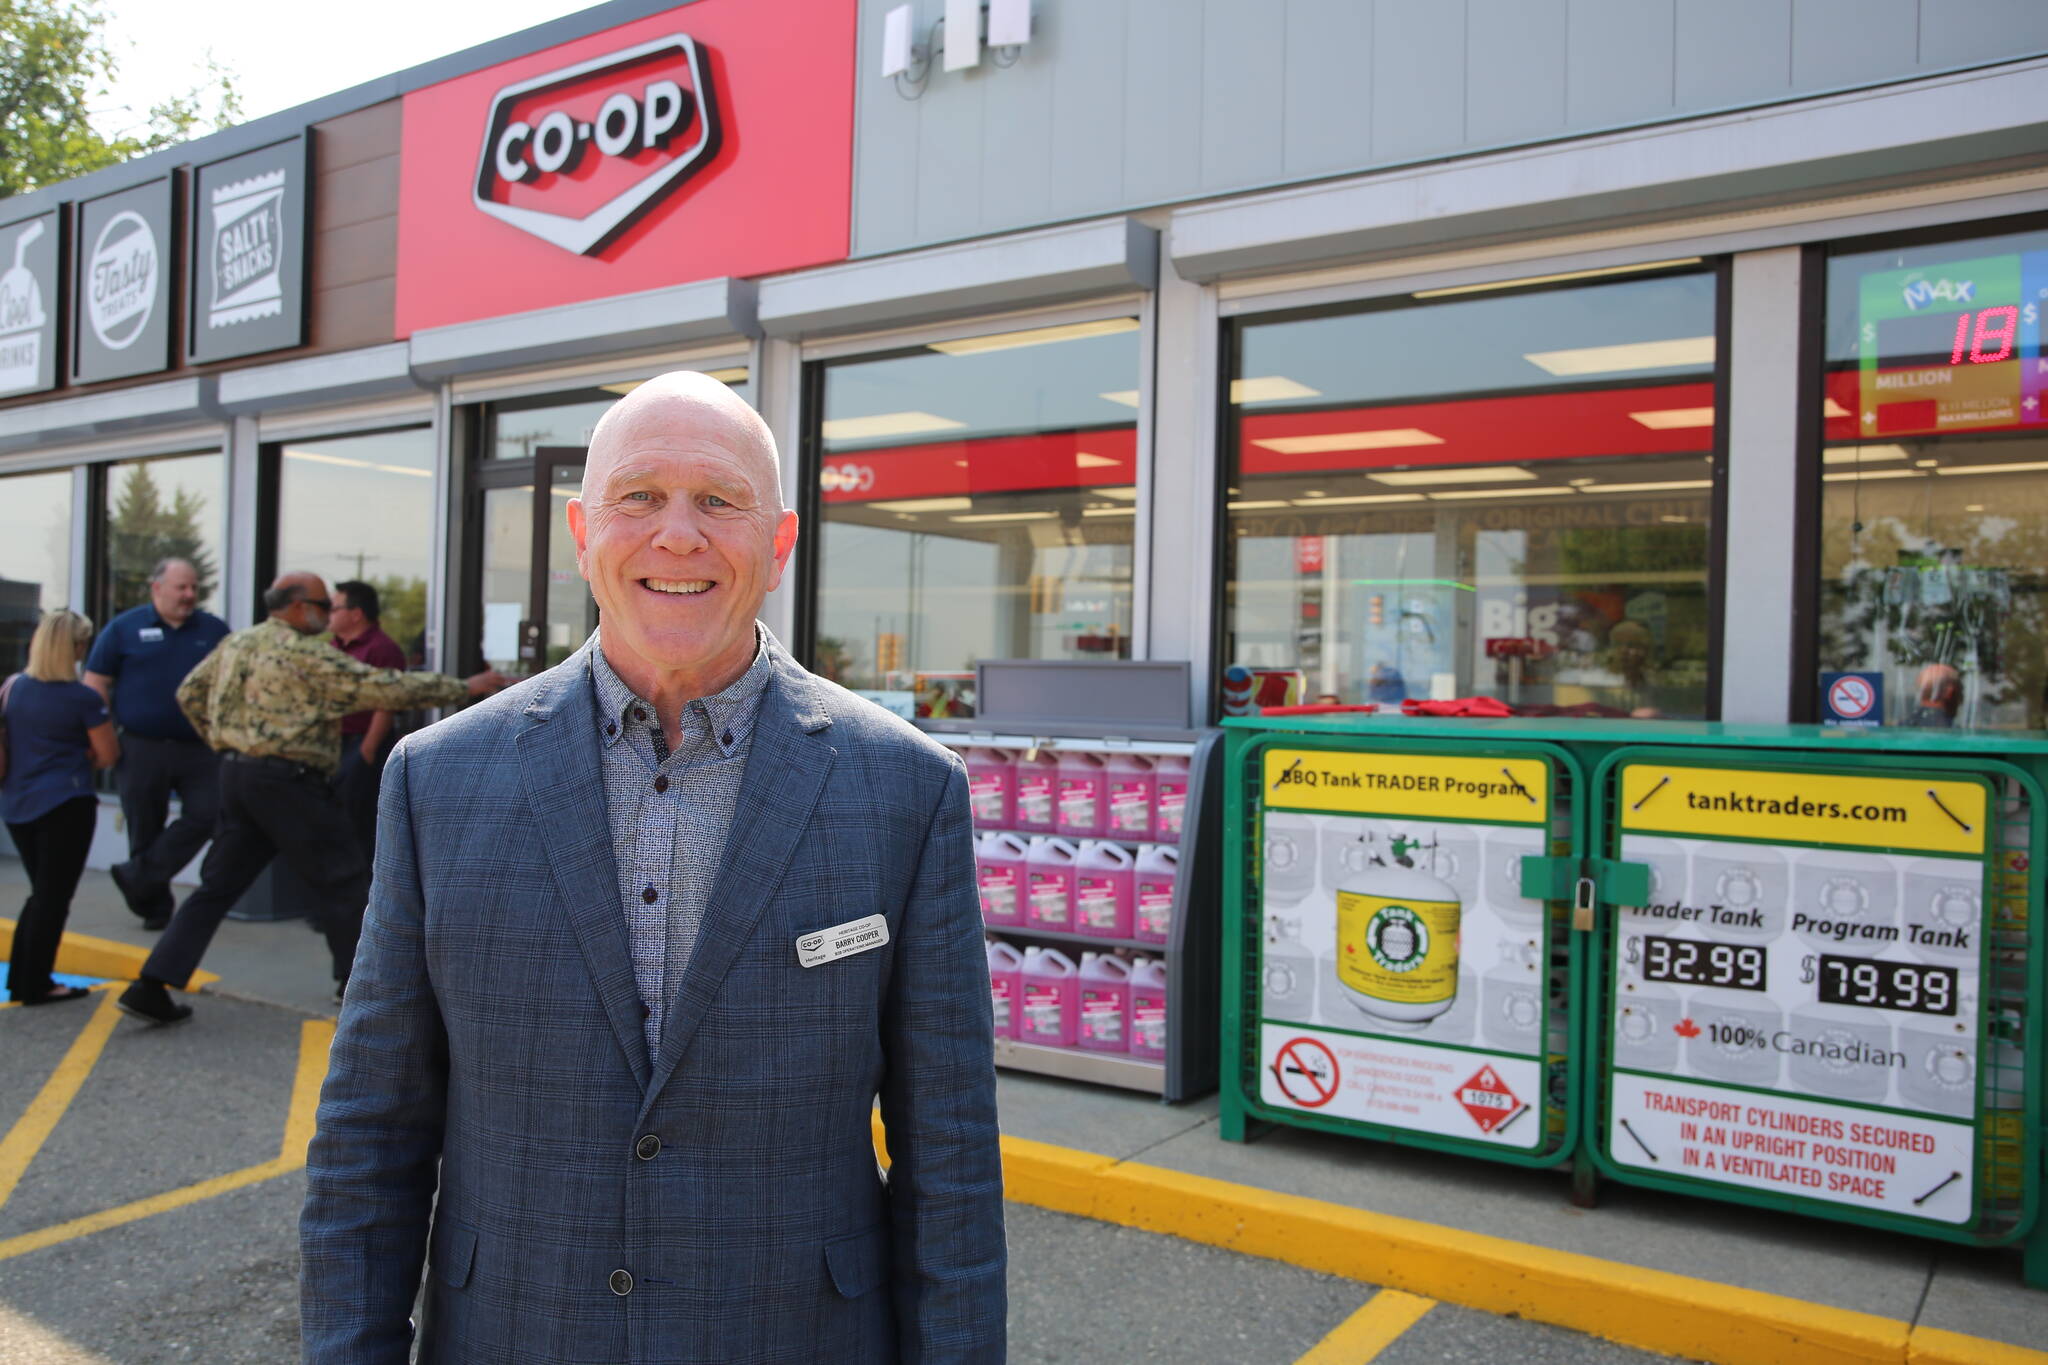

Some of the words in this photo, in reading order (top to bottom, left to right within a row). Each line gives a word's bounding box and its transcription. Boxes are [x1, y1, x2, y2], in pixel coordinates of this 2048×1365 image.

[496, 80, 682, 182] CO-OP
[222, 208, 269, 263] SALTY
[94, 249, 152, 303] Tasty
[223, 241, 273, 290] SNACKS
[102, 290, 138, 318] TREATS
[1903, 279, 1973, 311] MAX
[2022, 302, 2038, 325] $
[1951, 305, 2019, 365] 18
[0, 343, 34, 368] RINKS
[1876, 370, 1953, 390] MILLION
[1482, 591, 1560, 647] Big
[1281, 770, 1317, 787] BBQ
[1321, 772, 1362, 788] Tank
[1366, 773, 1440, 791] TRADER
[1445, 777, 1527, 799] Program
[1687, 792, 1907, 823] tanktraders.com
[1710, 905, 1764, 928] Tank
[1791, 913, 1899, 941] Program
[1908, 924, 1971, 948] Tank
[803, 938, 822, 948] CO-OP
[835, 937, 856, 950] BARRY
[856, 929, 880, 944] COOPER
[805, 954, 827, 963] Heritage
[1649, 941, 1762, 986] 32.99
[1827, 961, 1950, 1011] 79.99
[1708, 1023, 1767, 1049] 100%
[1772, 1031, 1907, 1069] Canadian
[1471, 1091, 1505, 1109] 1075
[1643, 1091, 1741, 1123] TRANSPORT
[1747, 1107, 1844, 1140] CYLINDERS
[1850, 1123, 1935, 1154] SECURED
[1680, 1122, 1697, 1141] IN
[1703, 1125, 1726, 1146] AN
[1732, 1129, 1807, 1160] UPRIGHT
[1812, 1143, 1896, 1175] POSITION
[1683, 1148, 1699, 1166] IN
[1705, 1151, 1716, 1170] A
[1721, 1153, 1822, 1188] VENTILATED
[1828, 1172, 1885, 1199] SPACE
